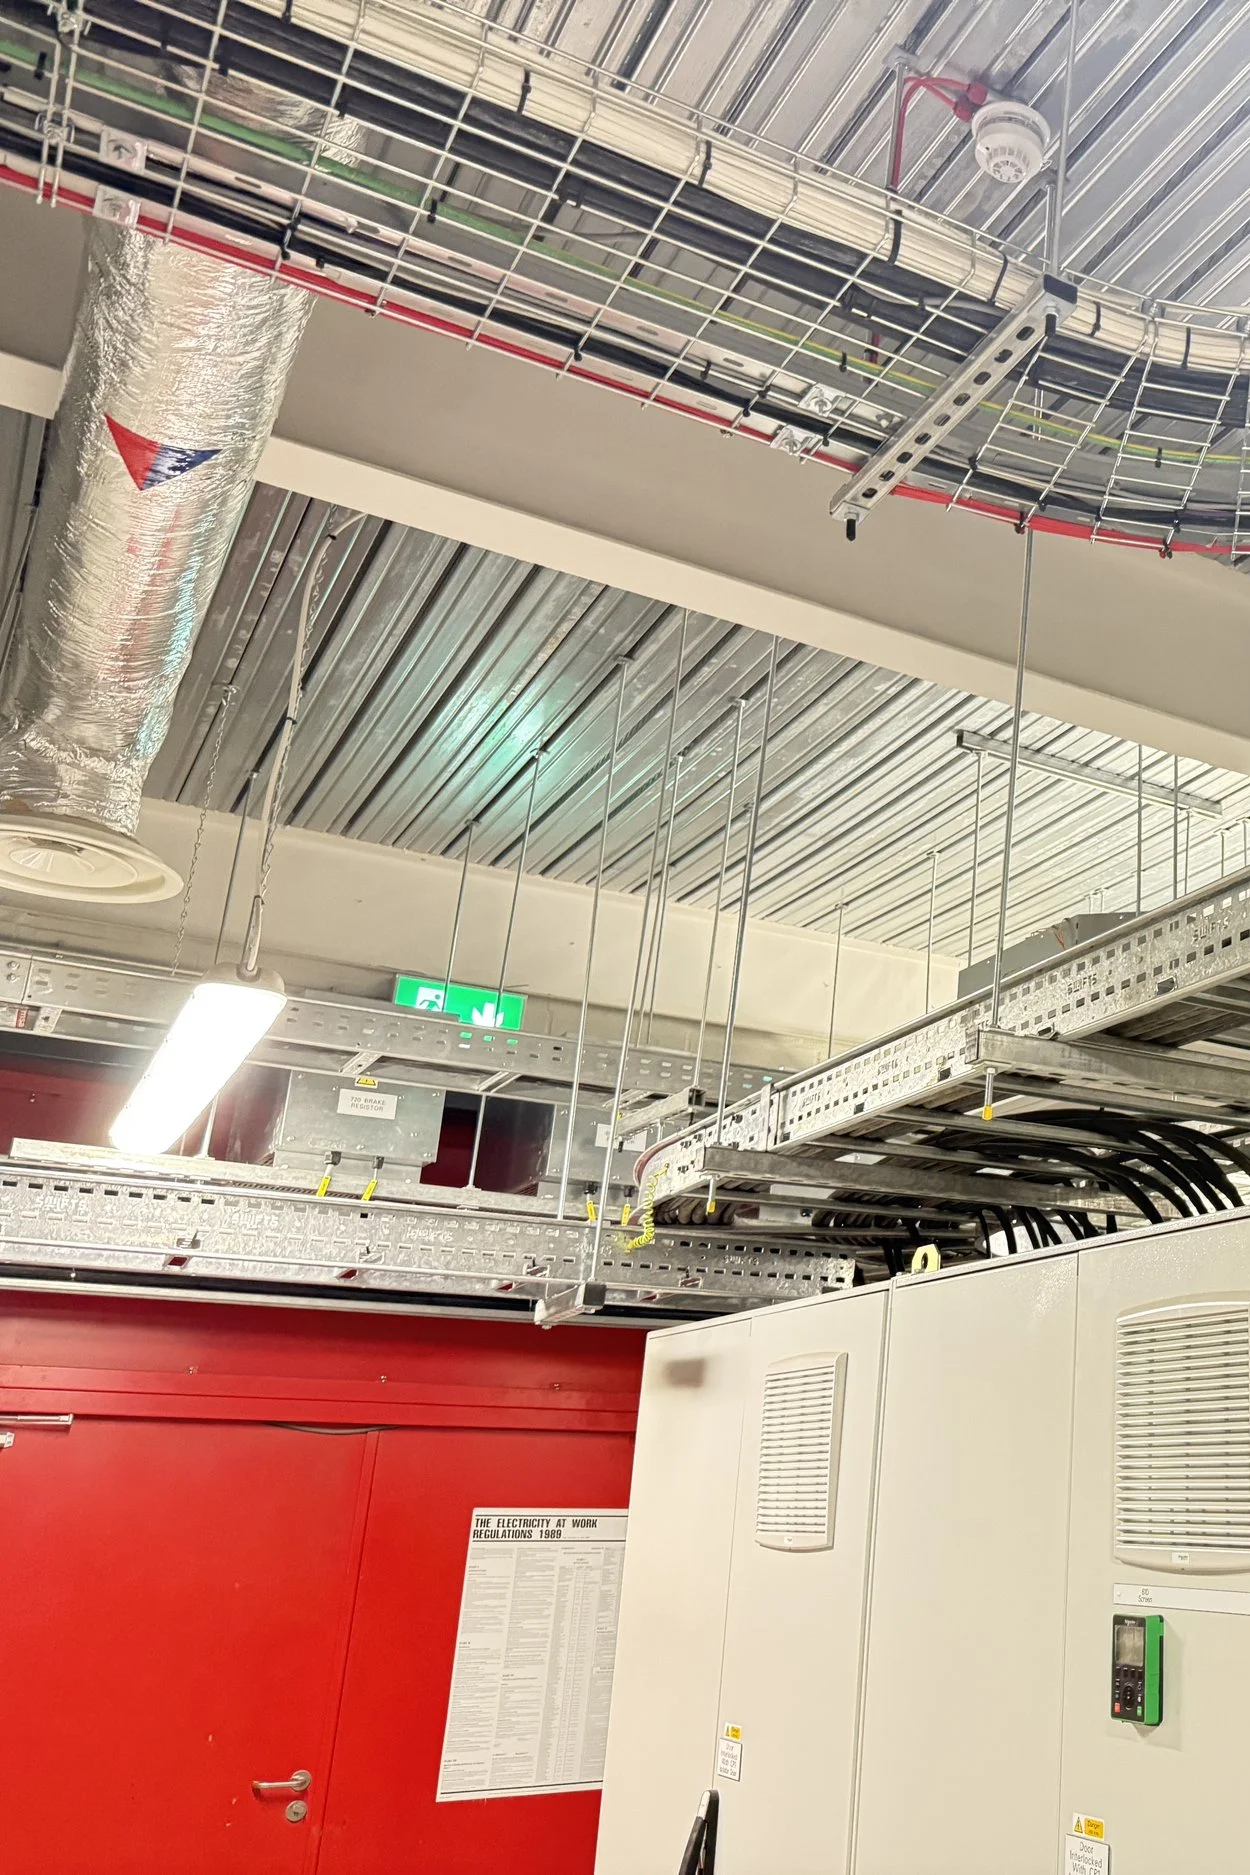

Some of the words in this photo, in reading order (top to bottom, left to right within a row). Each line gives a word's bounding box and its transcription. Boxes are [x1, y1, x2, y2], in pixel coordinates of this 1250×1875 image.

[350, 1103, 384, 1111] RESISTOR
[475, 1518, 491, 1528] THE
[496, 1518, 550, 1528] ELECTRICITY
[556, 1518, 566, 1528] AT
[572, 1518, 598, 1528] WORK
[472, 1529, 533, 1539] REGULATIONS
[539, 1529, 562, 1539] 1989
[1070, 1849, 1103, 1868] Interlocked
